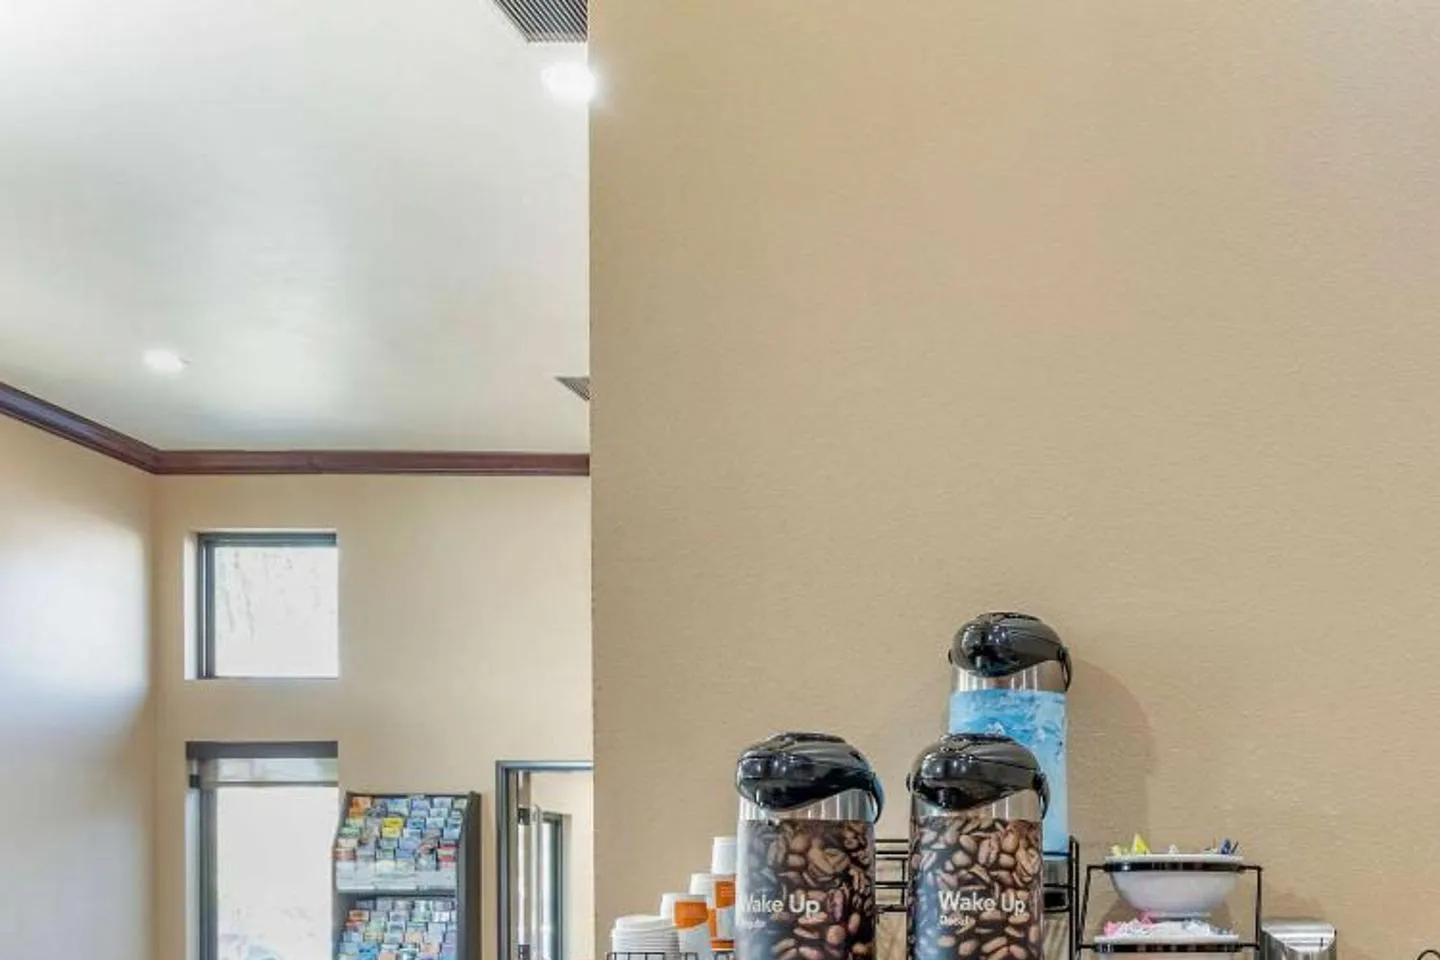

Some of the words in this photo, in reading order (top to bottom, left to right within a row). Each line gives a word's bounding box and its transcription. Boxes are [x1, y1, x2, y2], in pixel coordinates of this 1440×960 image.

[789, 893, 820, 918] Up
[938, 891, 996, 912] Wake
[1001, 892, 1026, 917] Up
